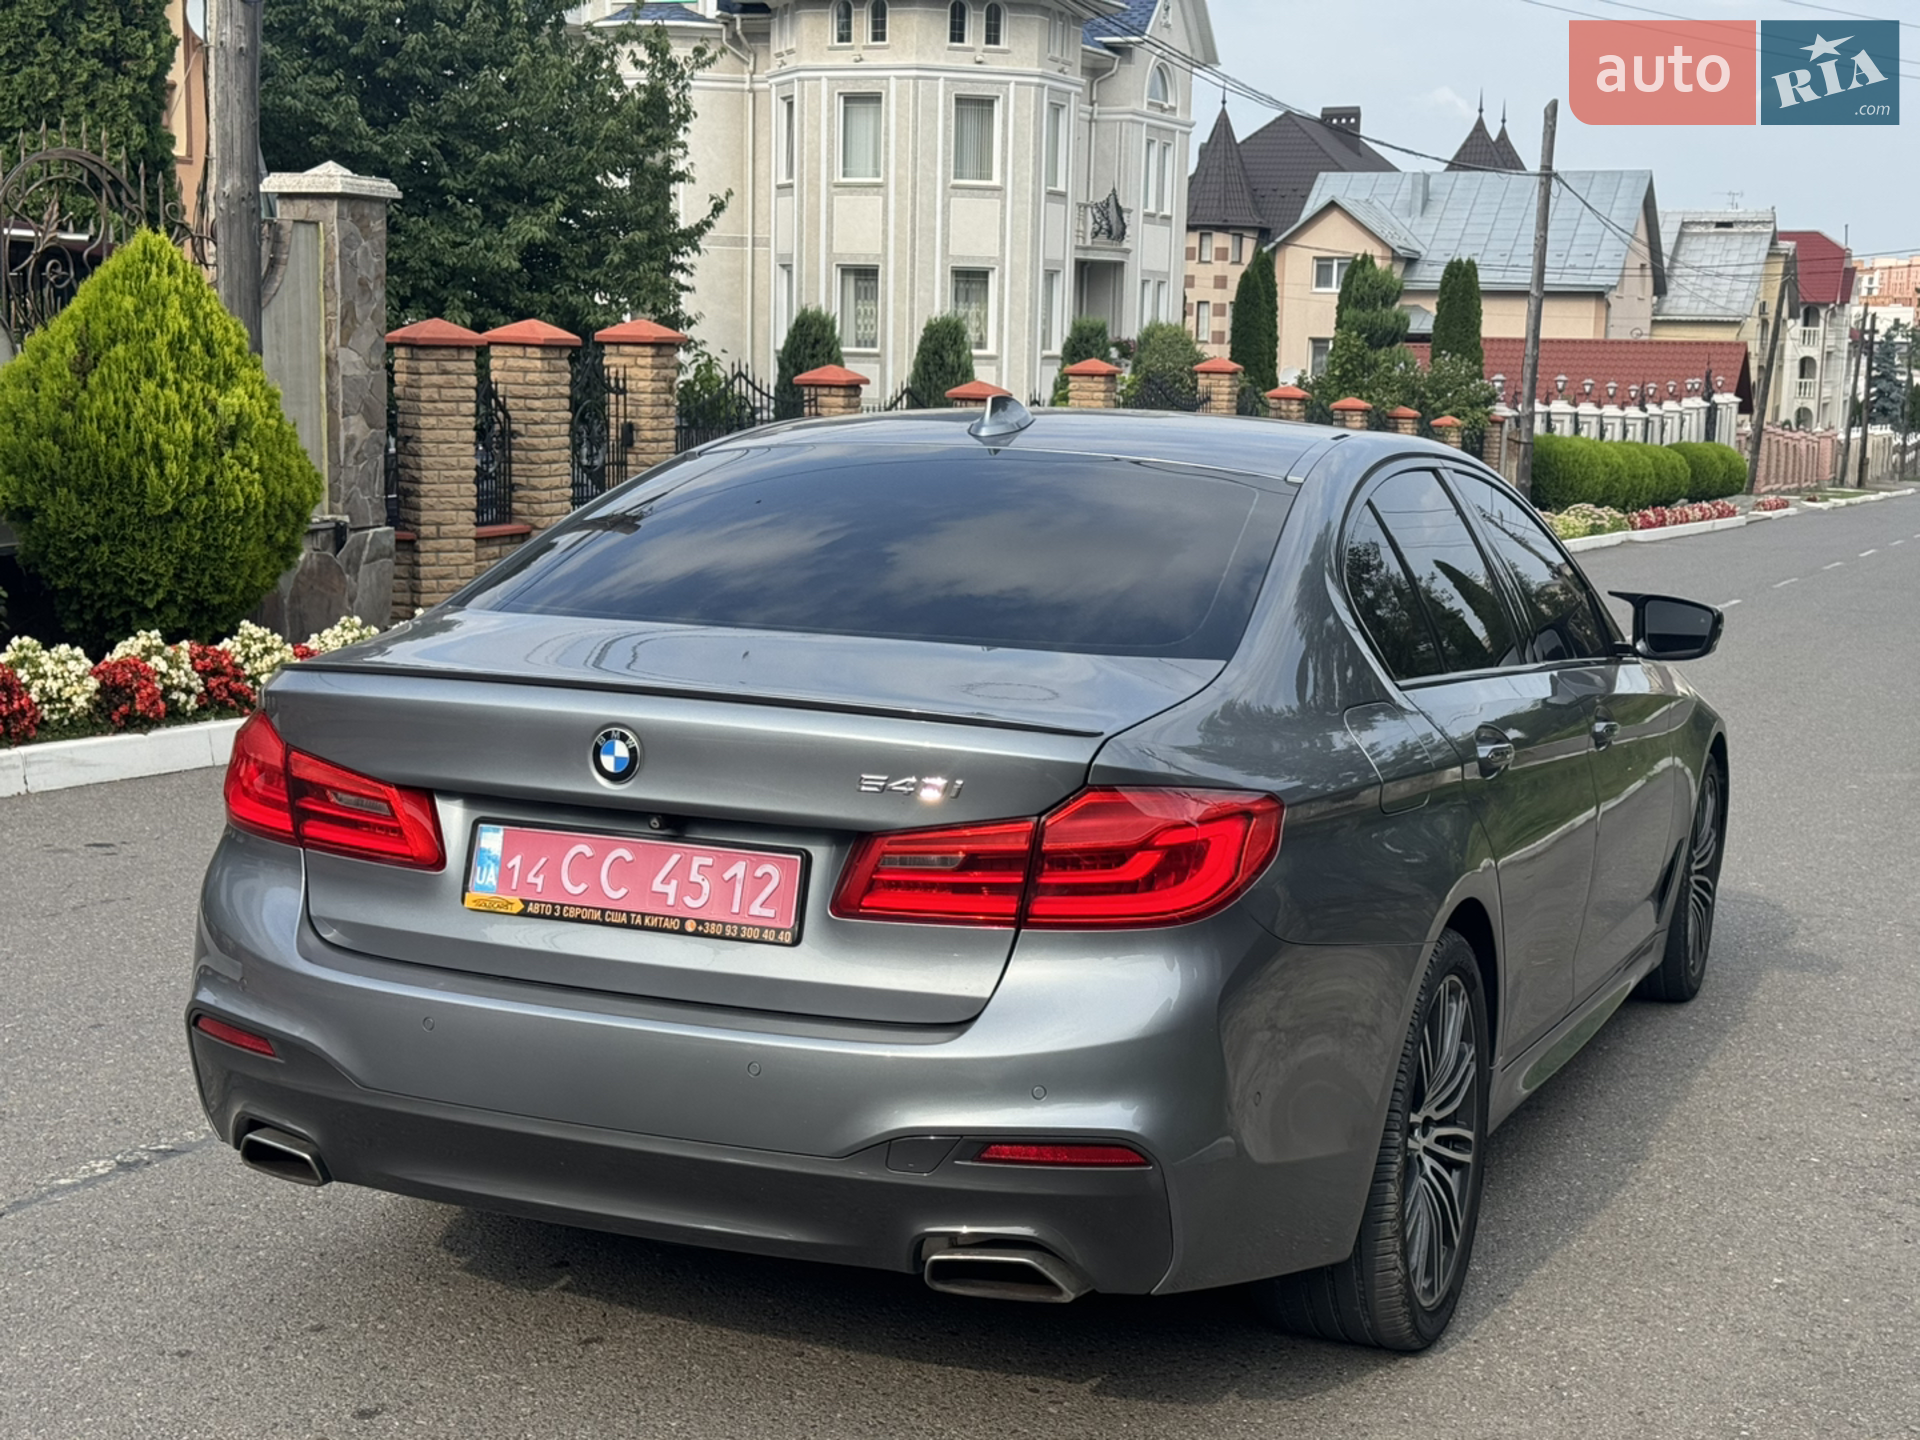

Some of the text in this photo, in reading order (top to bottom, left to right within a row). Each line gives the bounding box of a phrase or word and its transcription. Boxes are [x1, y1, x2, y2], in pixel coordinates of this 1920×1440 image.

[596, 730, 636, 749] BMW
[476, 862, 497, 886] UA
[506, 844, 781, 919] 14 CC 4512
[527, 902, 552, 916] АВТО
[604, 910, 628, 925] США
[630, 913, 642, 926] ТА
[644, 915, 681, 931] КИТАЮ
[697, 922, 723, 935] +380
[725, 924, 738, 937] 93
[740, 926, 760, 939] 300
[762, 928, 776, 941] 40
[777, 930, 792, 943] 40
